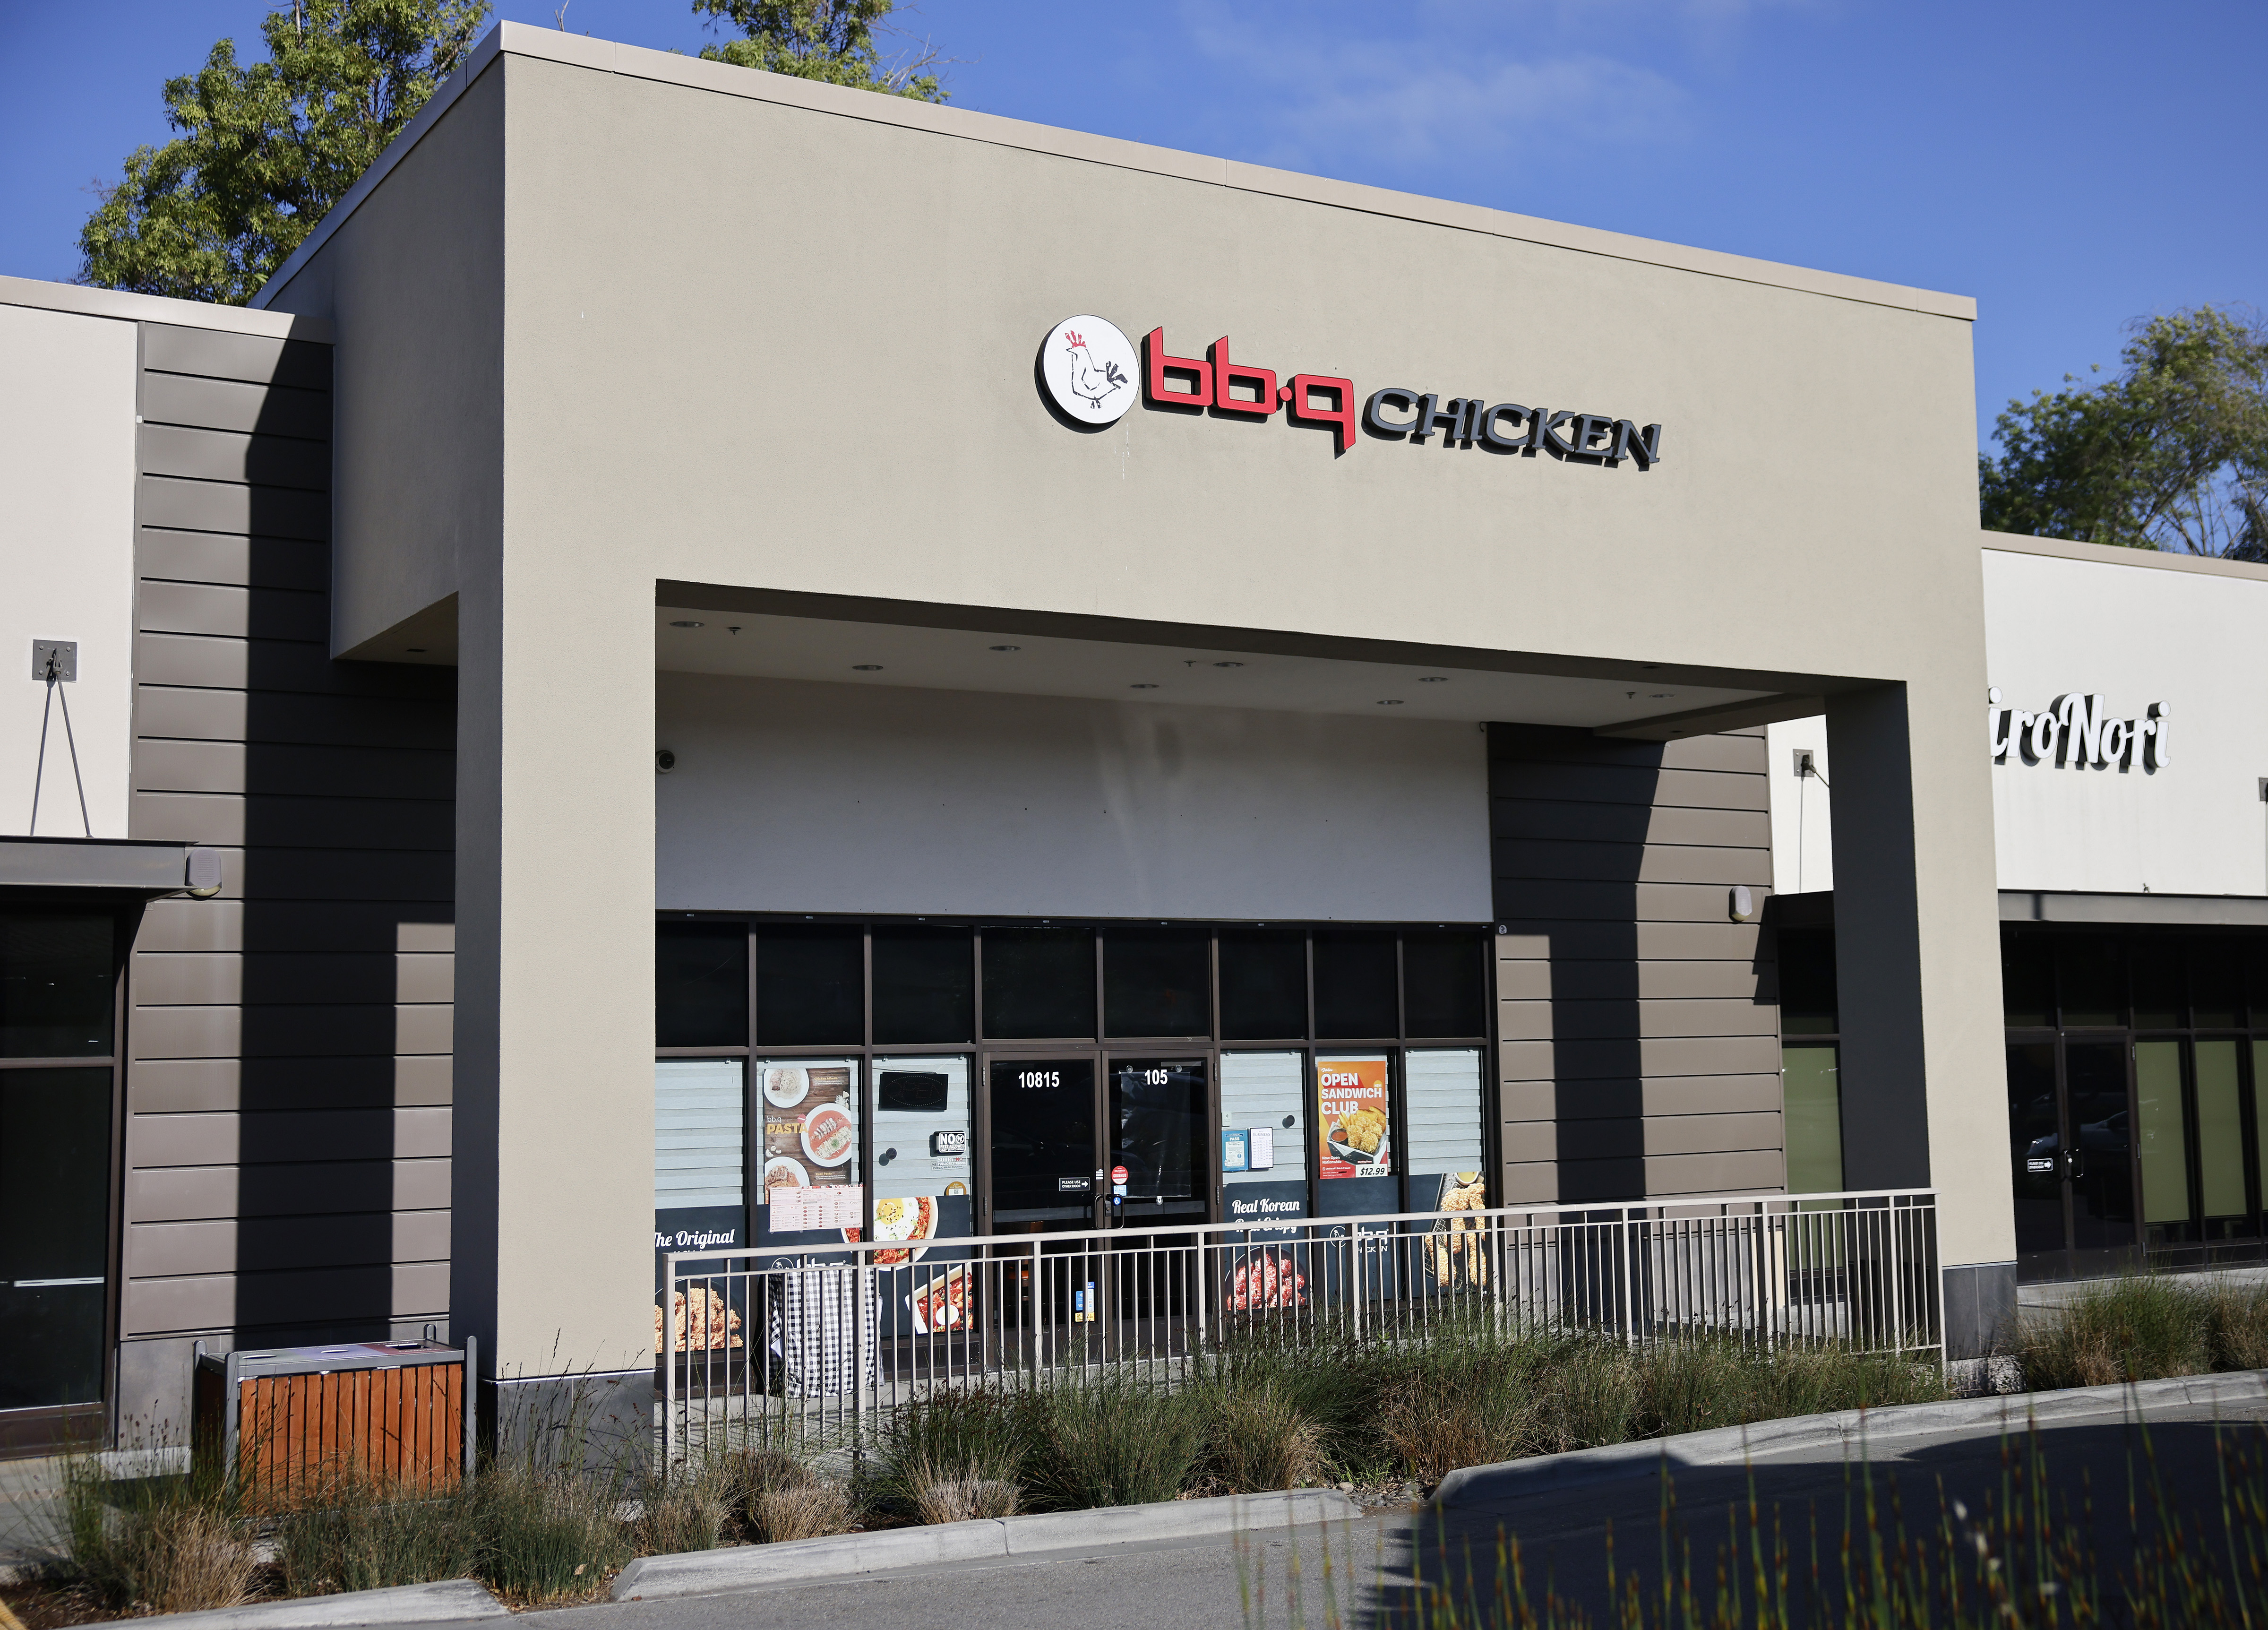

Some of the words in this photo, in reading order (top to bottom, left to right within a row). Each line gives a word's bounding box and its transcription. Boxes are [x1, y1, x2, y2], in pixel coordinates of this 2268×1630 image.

[1366, 387, 1662, 468] CHICKEN
[1019, 1071, 1060, 1088] 10815
[1144, 1069, 1168, 1085] 105
[1321, 1073, 1358, 1086] OPEN
[1321, 1087, 1382, 1099] SANDWICH
[1321, 1101, 1358, 1115] CLUB
[767, 1115, 782, 1123] bb.q
[767, 1123, 808, 1134] PASTA
[940, 1133, 955, 1145] NO
[1360, 1167, 1385, 1176] $12.99
[1232, 1199, 1258, 1214] Real
[1260, 1198, 1300, 1212] Korean
[676, 1229, 735, 1249] Original
